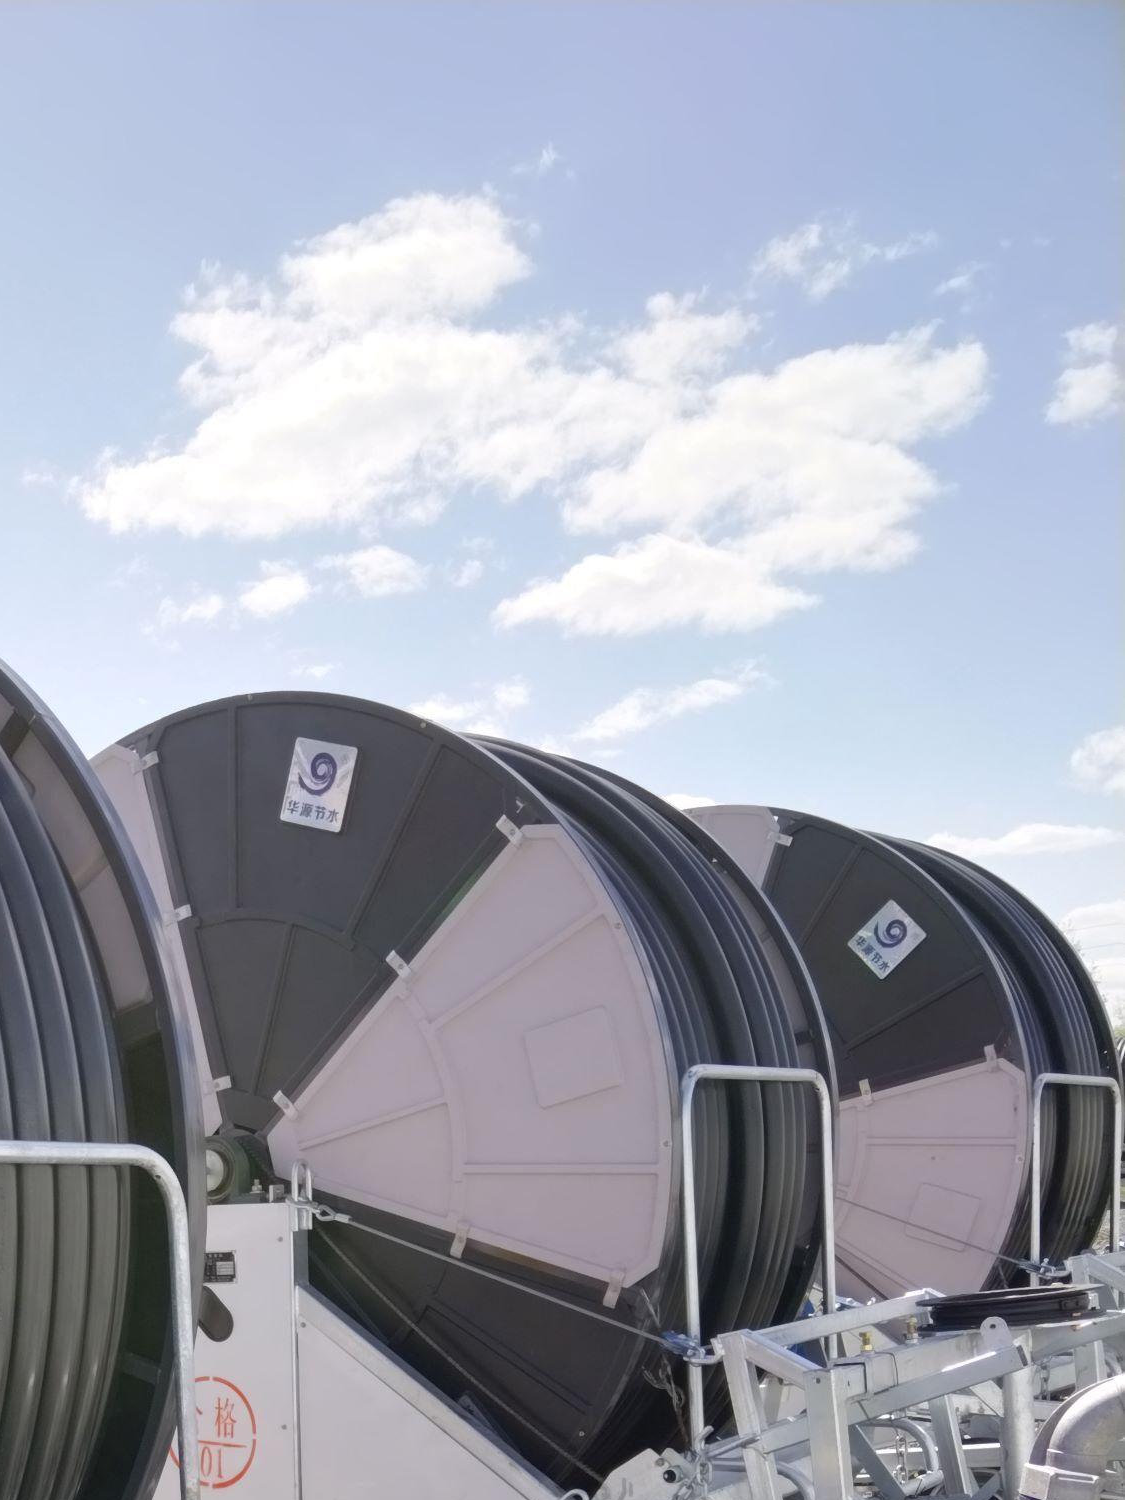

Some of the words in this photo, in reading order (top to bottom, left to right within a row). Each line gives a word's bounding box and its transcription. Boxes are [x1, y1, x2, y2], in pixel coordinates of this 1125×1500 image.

[287, 800, 339, 823] 华源节水
[200, 1446, 224, 1479] 01
